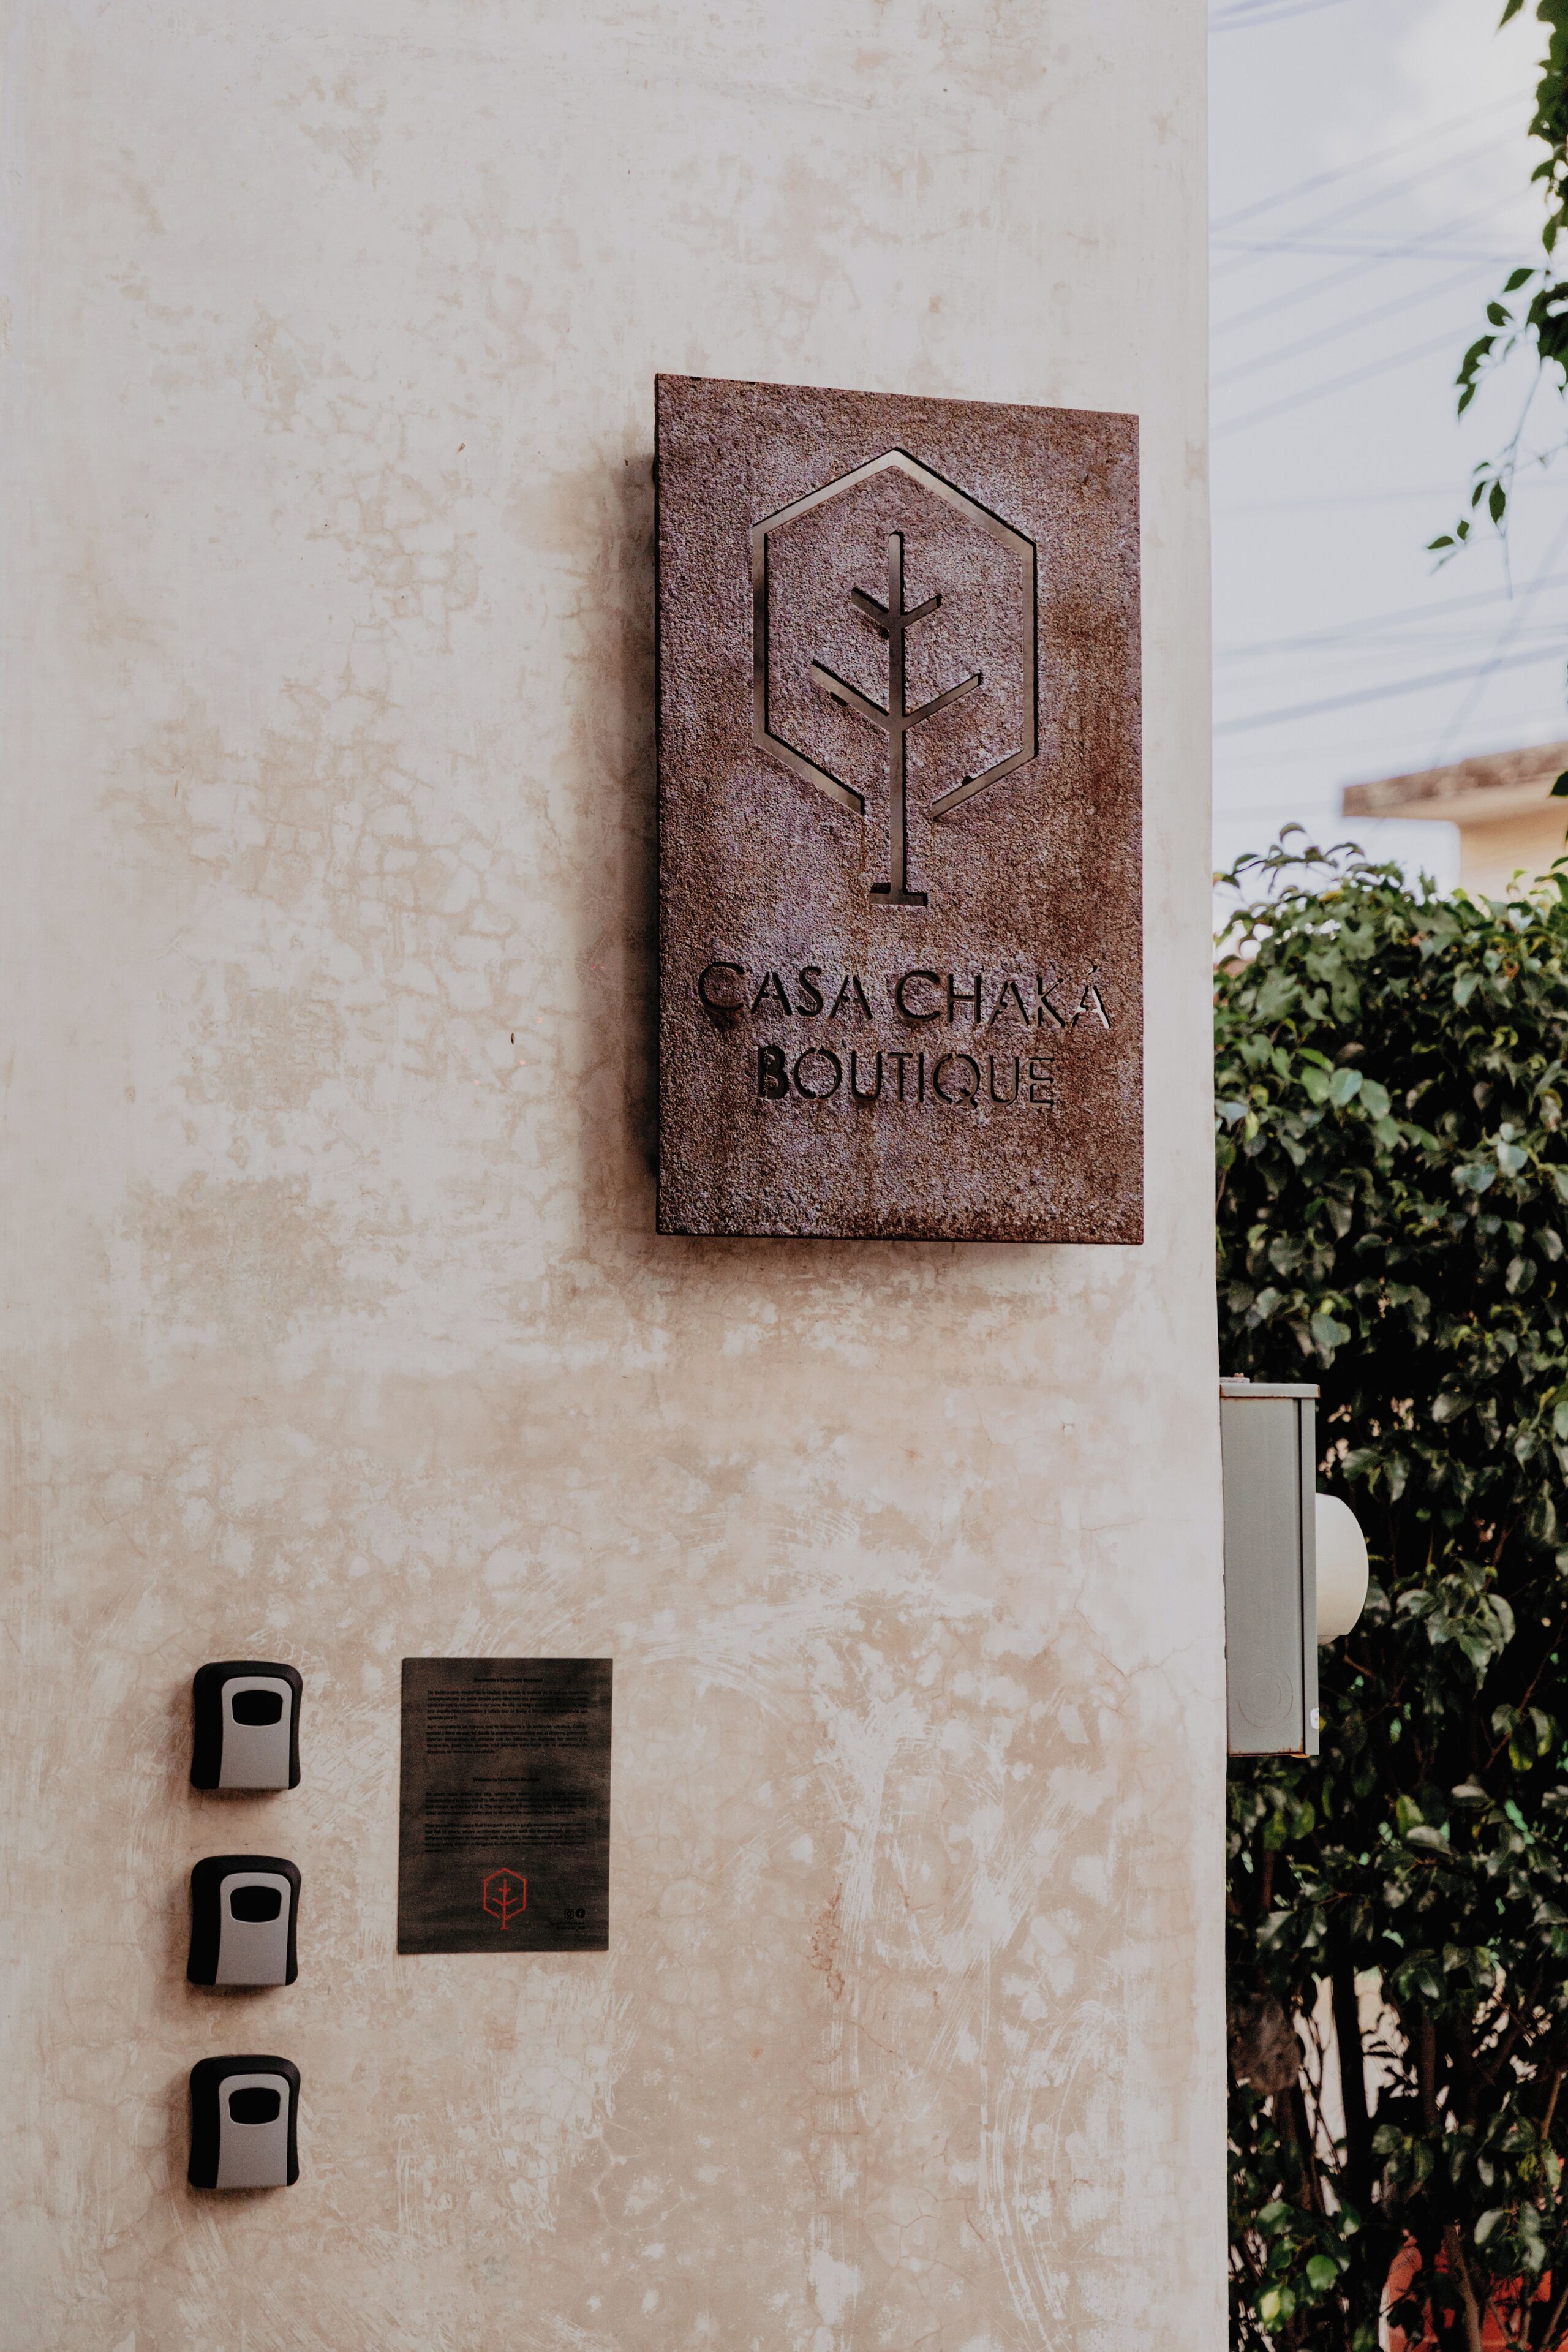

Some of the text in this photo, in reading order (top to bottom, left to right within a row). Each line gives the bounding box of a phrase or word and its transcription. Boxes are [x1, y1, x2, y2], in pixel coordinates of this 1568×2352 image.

[698, 962, 1112, 1030] CASA CHAKÁ
[756, 1044, 1055, 1109] BOUTIQUE
